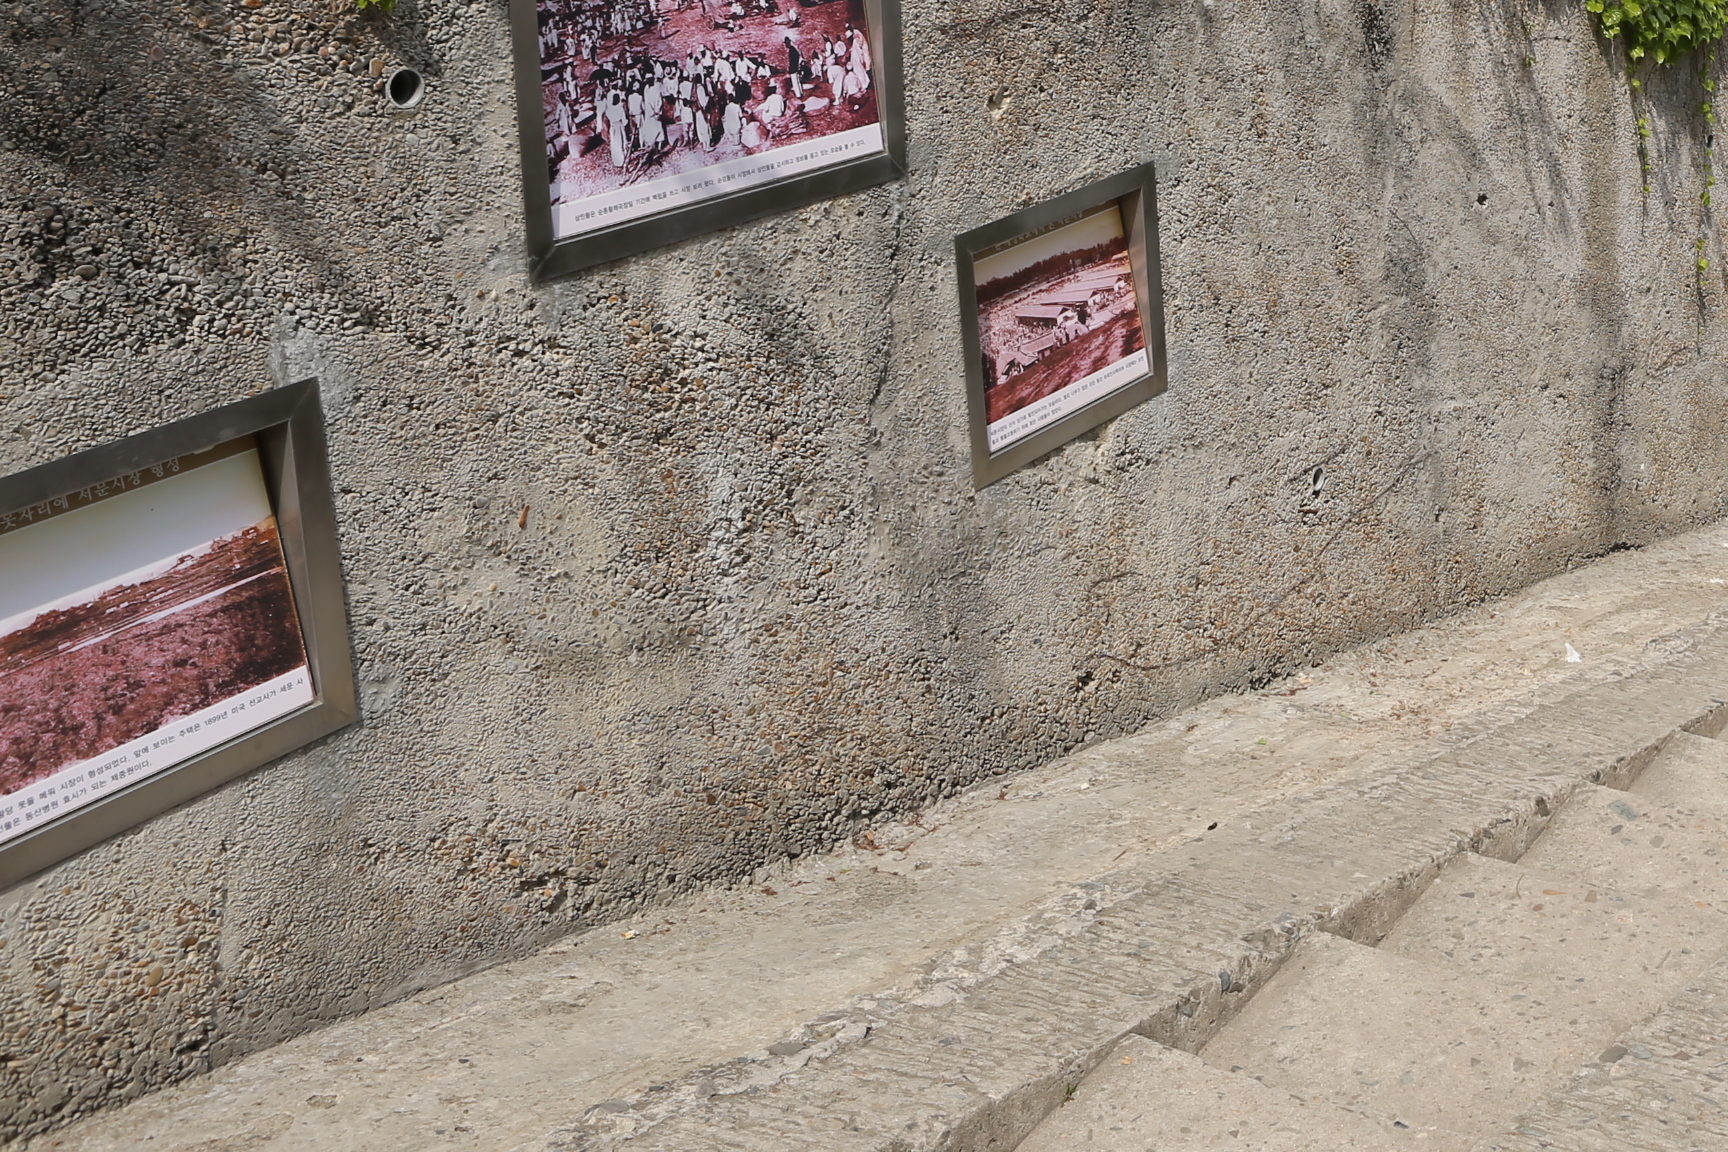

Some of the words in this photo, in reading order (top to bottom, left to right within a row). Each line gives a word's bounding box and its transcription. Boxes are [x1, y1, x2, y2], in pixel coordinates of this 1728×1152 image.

[575, 211, 595, 222] 상인들은
[681, 184, 691, 192] 시장
[78, 472, 142, 501] 서문시장
[151, 458, 180, 478] 형성
[18, 797, 34, 810] 못을
[60, 775, 84, 790] 시장이
[88, 755, 130, 778] 형성되었다.
[133, 746, 149, 758] 앞에
[153, 736, 175, 750] 보이는
[179, 723, 201, 737] 주택은
[204, 711, 228, 726] 1899년
[231, 703, 245, 714] 미국
[249, 689, 276, 707] 선교사가
[280, 682, 293, 692] 세운
[25, 800, 59, 821] 동산병원
[63, 787, 87, 804] 효시가
[91, 780, 106, 791] 되는
[111, 760, 152, 781] 제중원이다.
